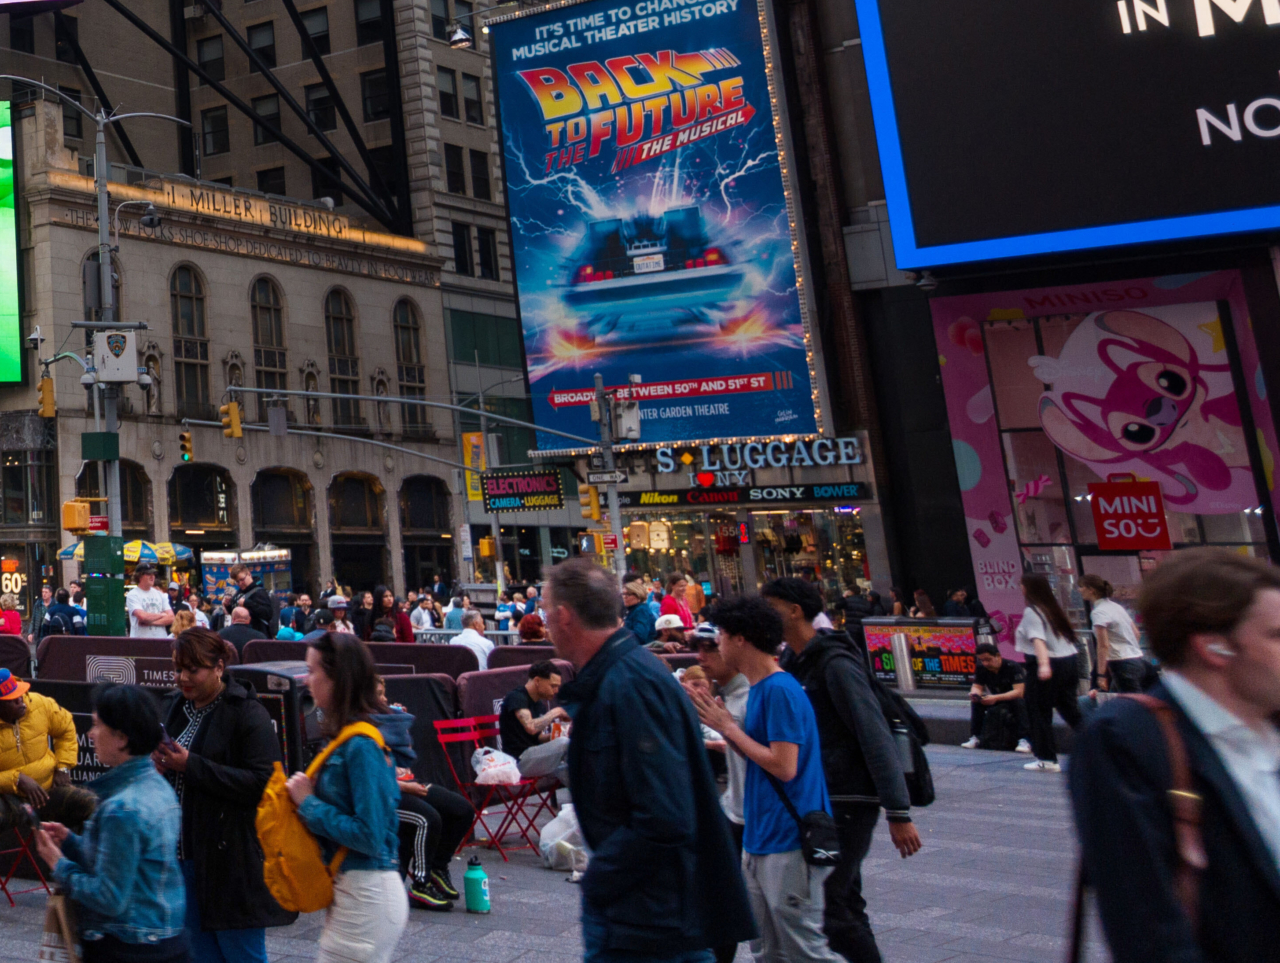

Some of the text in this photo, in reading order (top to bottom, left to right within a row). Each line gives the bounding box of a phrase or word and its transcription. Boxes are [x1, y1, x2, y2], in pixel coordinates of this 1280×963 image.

[566, 14, 605, 32] TIME
[608, 6, 631, 21] TO
[512, 36, 581, 61] MUSICAL
[584, 16, 660, 43] THEATER
[516, 49, 724, 120] BACK
[546, 76, 745, 159] TO FUTURE
[641, 110, 745, 160] THE MUSICAL
[545, 142, 586, 174] THE
[190, 190, 254, 218] MILLER
[269, 204, 343, 234] BUILDING
[68, 209, 92, 226] THE
[179, 229, 209, 246] SHOE
[214, 236, 242, 252] SHOP
[246, 240, 303, 262] DEDICATED
[307, 250, 320, 265] TO
[367, 260, 378, 275] IN
[1024, 287, 1148, 310] MINISO
[617, 386, 673, 398] BETWEEN
[700, 380, 726, 391] AND
[751, 377, 765, 387] ST
[660, 403, 730, 418] GARDEN THEATRE
[701, 437, 861, 471] LUGGAGE
[487, 476, 557, 495] ELECTRONICS
[687, 470, 749, 486] I NY
[490, 495, 559, 508] CAMERA LUGGAGE
[640, 492, 678, 504] Nikon
[687, 490, 741, 503] Canon
[749, 488, 805, 500] SONY
[813, 486, 859, 498] BOWER
[1098, 495, 1157, 515] MINI
[978, 560, 1017, 575] BLIND
[983, 573, 1019, 590] BOX
[875, 655, 976, 673] A OF THE TIMES
[143, 670, 175, 681] TIMES
